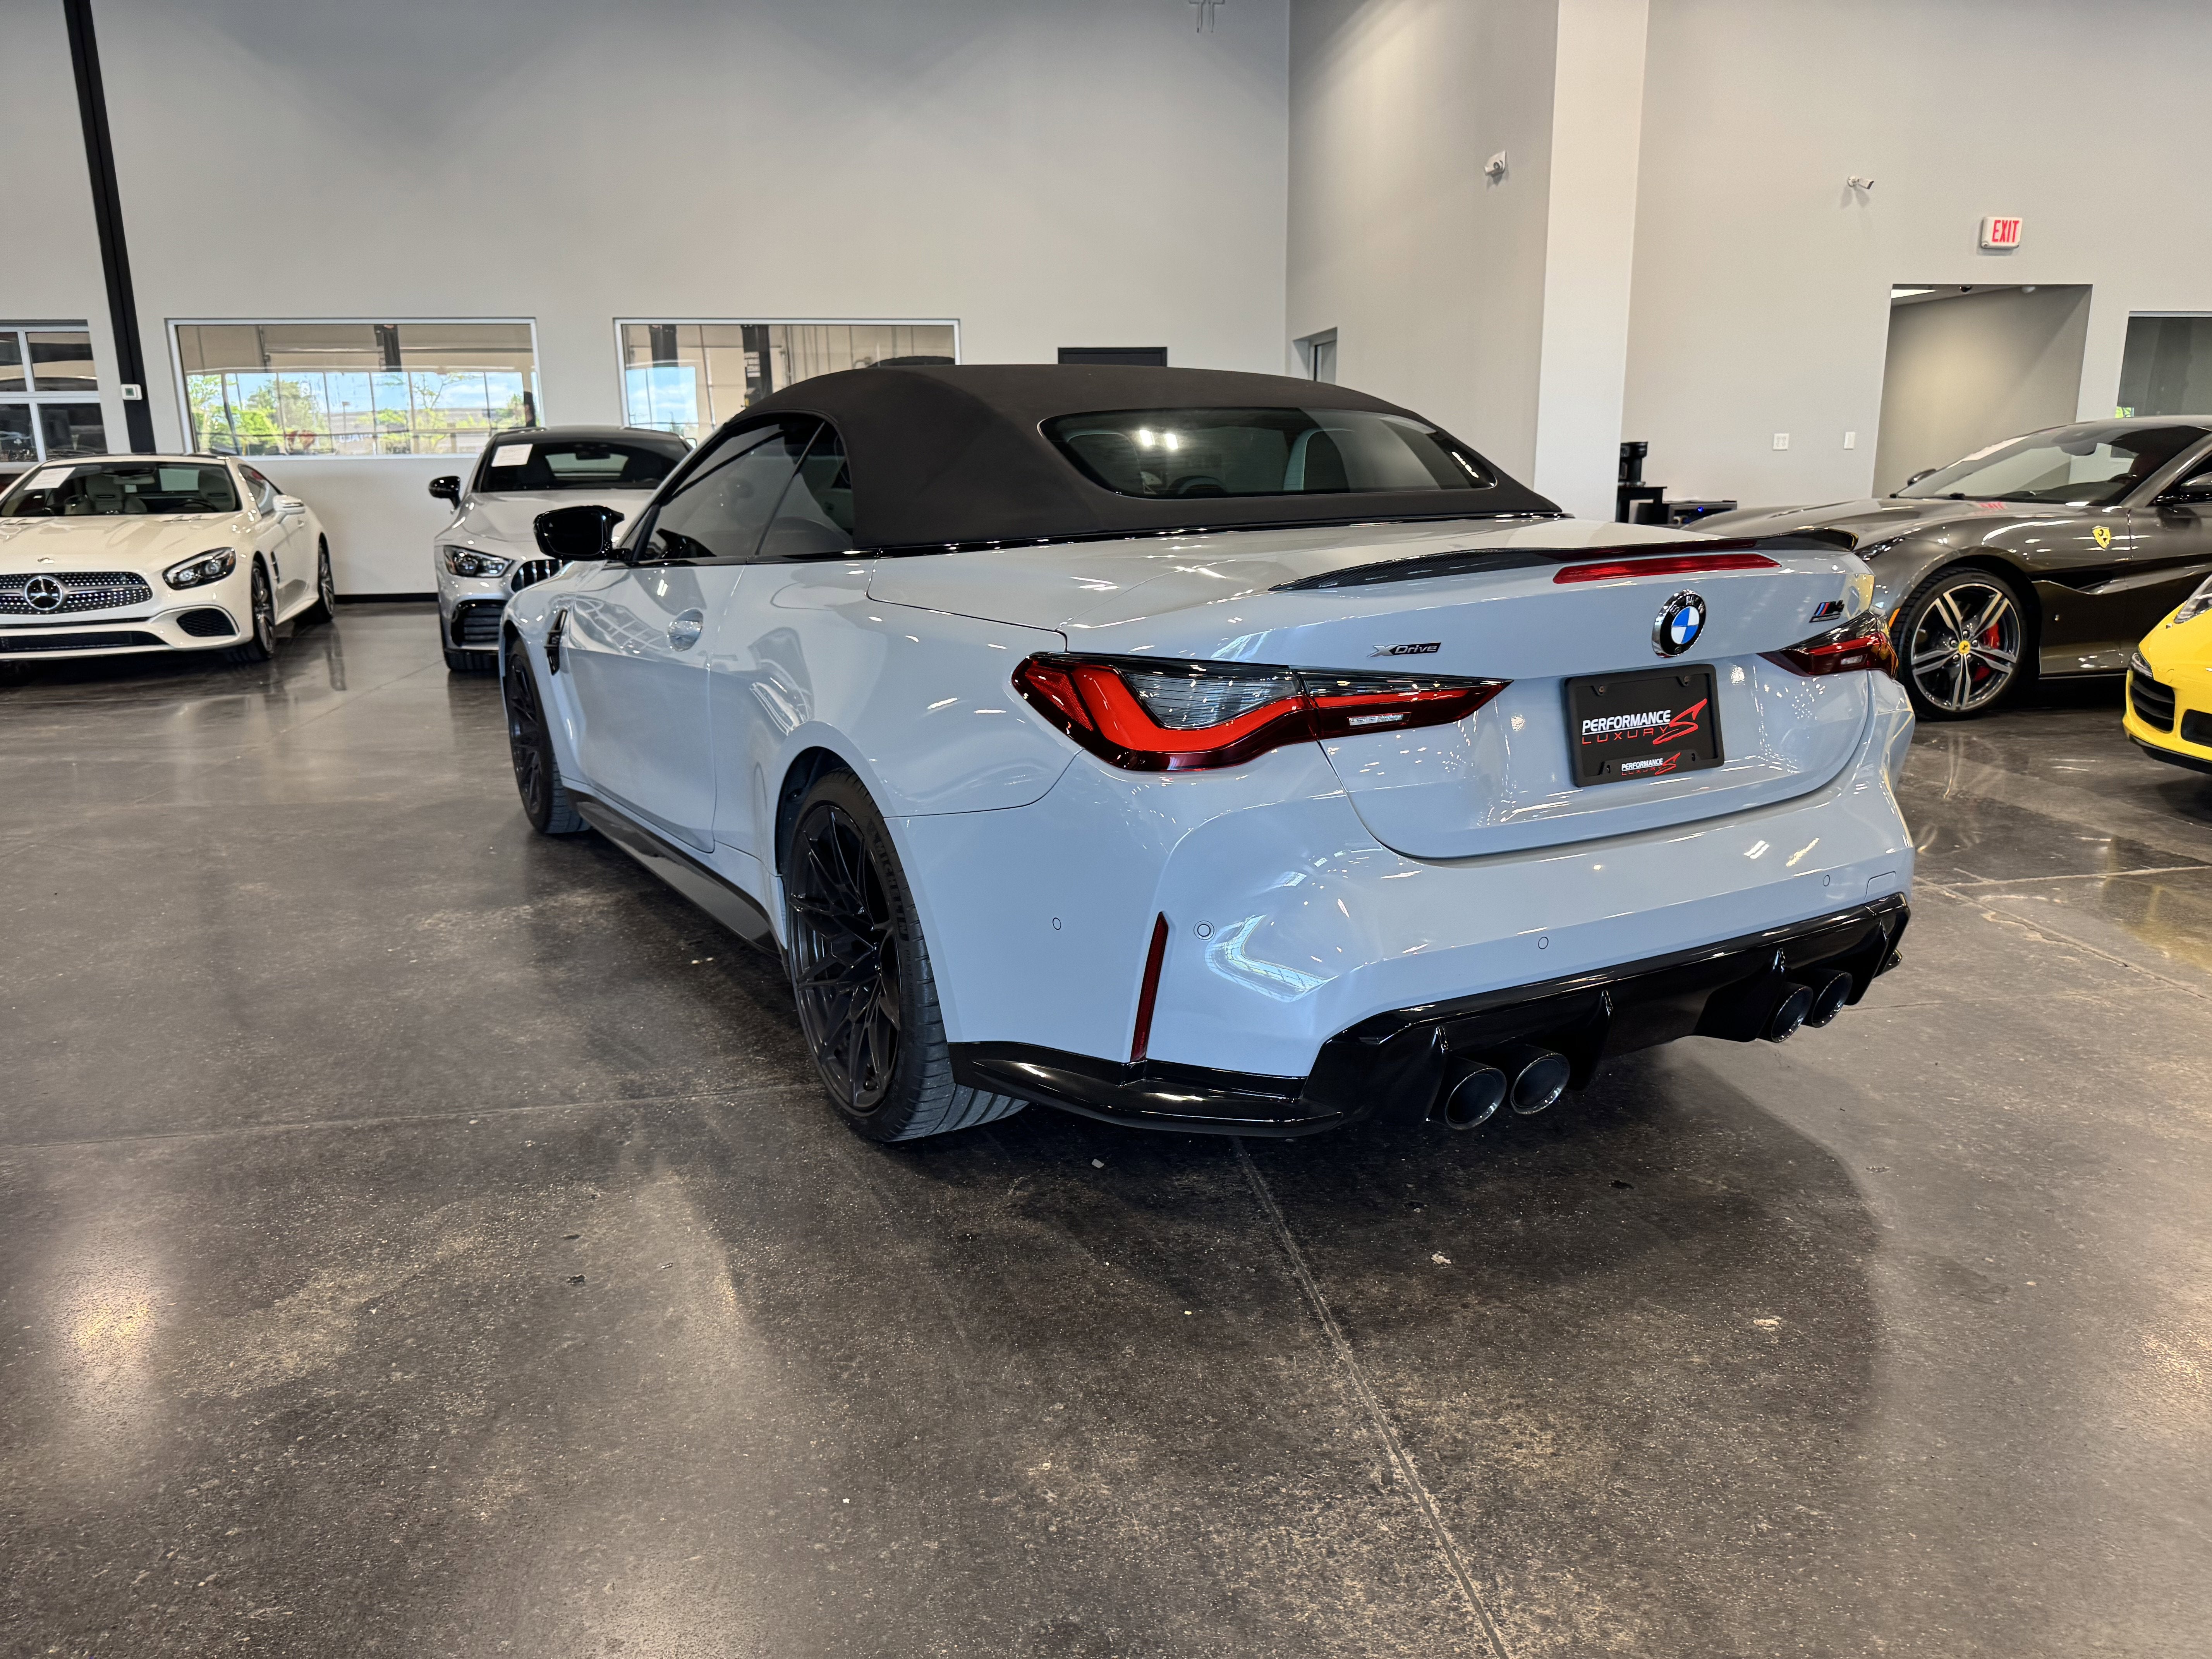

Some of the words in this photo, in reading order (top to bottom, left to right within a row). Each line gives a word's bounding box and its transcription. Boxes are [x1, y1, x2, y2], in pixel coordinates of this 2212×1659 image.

[1992, 220, 2019, 242] EXIT
[1582, 709, 1671, 733] PERFORMANCE
[1582, 726, 1668, 745] LUXURY
[1621, 758, 1663, 770] PERFORMANCE
[1621, 766, 1662, 776] LUXURY
[874, 840, 908, 935] MICHELIN
